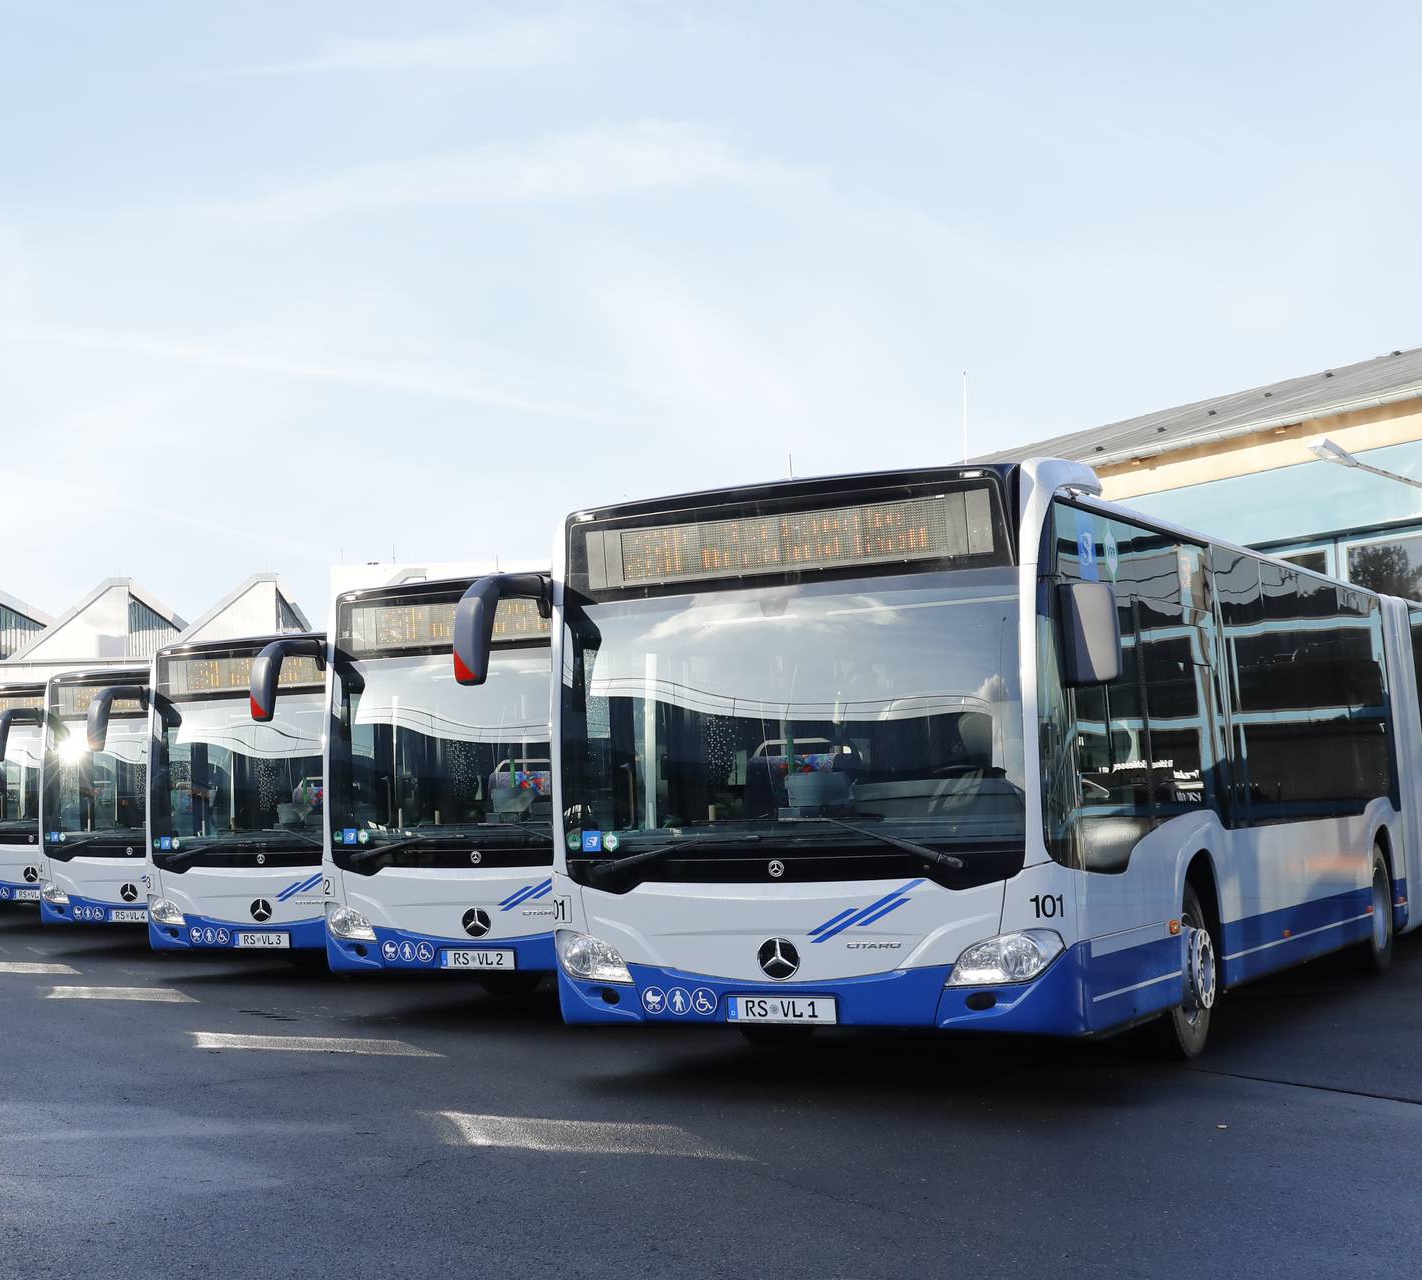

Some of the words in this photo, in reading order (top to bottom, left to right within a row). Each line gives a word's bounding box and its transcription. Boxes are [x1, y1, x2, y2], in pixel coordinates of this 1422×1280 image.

[145, 876, 151, 889] 3
[324, 879, 331, 895] 2
[1029, 894, 1064, 919] 101
[115, 911, 126, 920] RS
[129, 911, 140, 920] VL
[140, 911, 146, 920] 4
[243, 935, 256, 945] RS
[261, 935, 274, 945] VL
[275, 934, 282, 945] 3
[846, 942, 902, 950] CITARO
[453, 952, 470, 966] RS
[477, 952, 494, 966] VL
[495, 953, 504, 966] 2
[745, 1000, 768, 1018] RS
[780, 1000, 804, 1018] VL
[808, 1001, 819, 1018] 1
